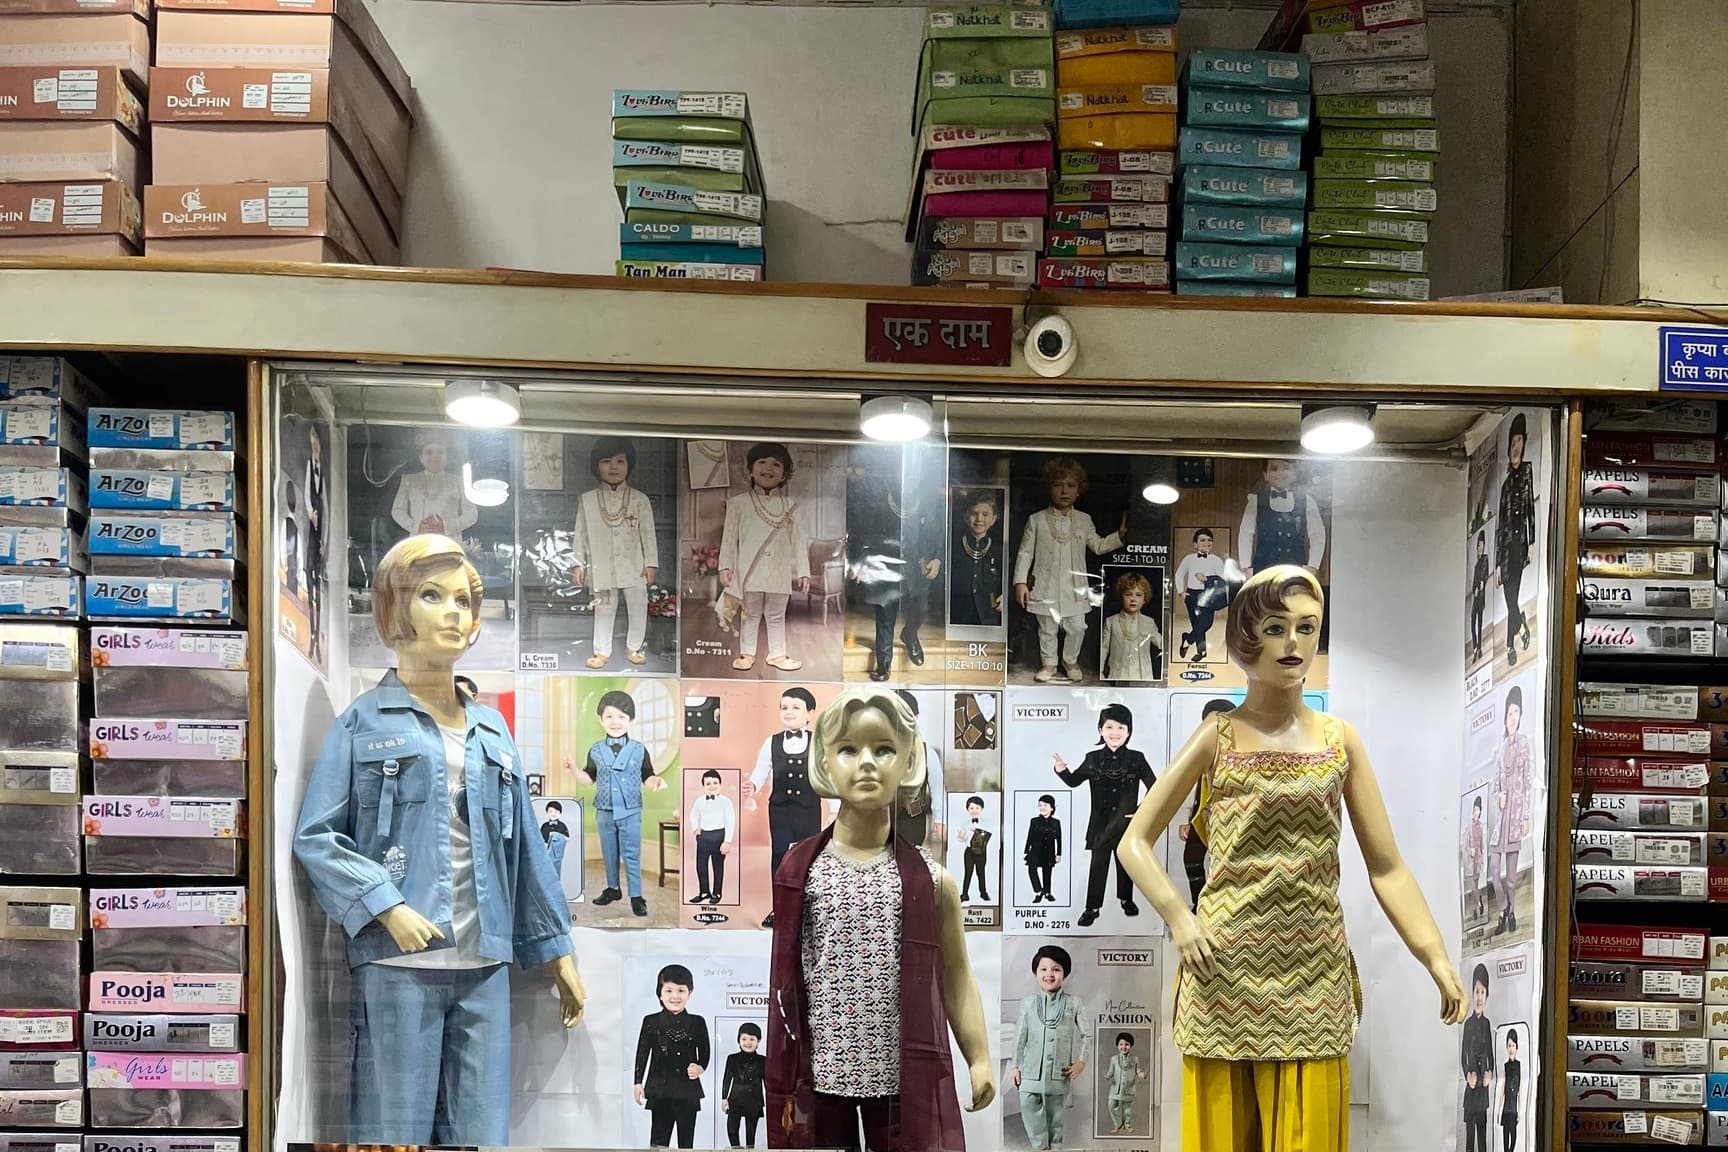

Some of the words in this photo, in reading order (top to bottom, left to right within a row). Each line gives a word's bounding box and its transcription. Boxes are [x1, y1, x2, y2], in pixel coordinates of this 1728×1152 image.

[167, 94, 231, 108] DOLPHIN
[162, 211, 227, 224] DOLPHIN
[633, 223, 680, 233] CALDO
[624, 265, 651, 277] Tan
[655, 266, 687, 277] Man
[883, 317, 931, 351] एक
[940, 319, 992, 348] दाम
[1670, 361, 1699, 378] पीस
[1584, 469, 1640, 482] PAPELS
[1584, 507, 1638, 520] PAPELS
[96, 523, 157, 544] ArZoo
[1126, 545, 1168, 554] CREAM
[1141, 555, 1153, 563] TO
[1155, 555, 1166, 564] 10
[97, 633, 141, 649] GIRLS
[968, 643, 988, 657] BK
[977, 661, 988, 670] TO
[990, 661, 1003, 671] 10
[1016, 708, 1064, 717] VICTORY
[96, 725, 139, 741] GIRLS
[89, 801, 132, 817] GIRLS
[96, 894, 138, 910] GIRLS
[1015, 910, 1047, 918] PURPLE
[1024, 920, 1044, 929] D.NO
[1051, 920, 1070, 929] 2276
[1600, 936, 1640, 946] FASHION
[1102, 953, 1149, 962] VICTORY
[101, 980, 165, 1003] Pooja
[731, 997, 769, 1005] VICTOR
[1099, 1014, 1152, 1023] FASHION
[92, 1020, 156, 1043] Pooja
[1576, 1040, 1629, 1052] PAPELS
[126, 1056, 169, 1083] Girls
